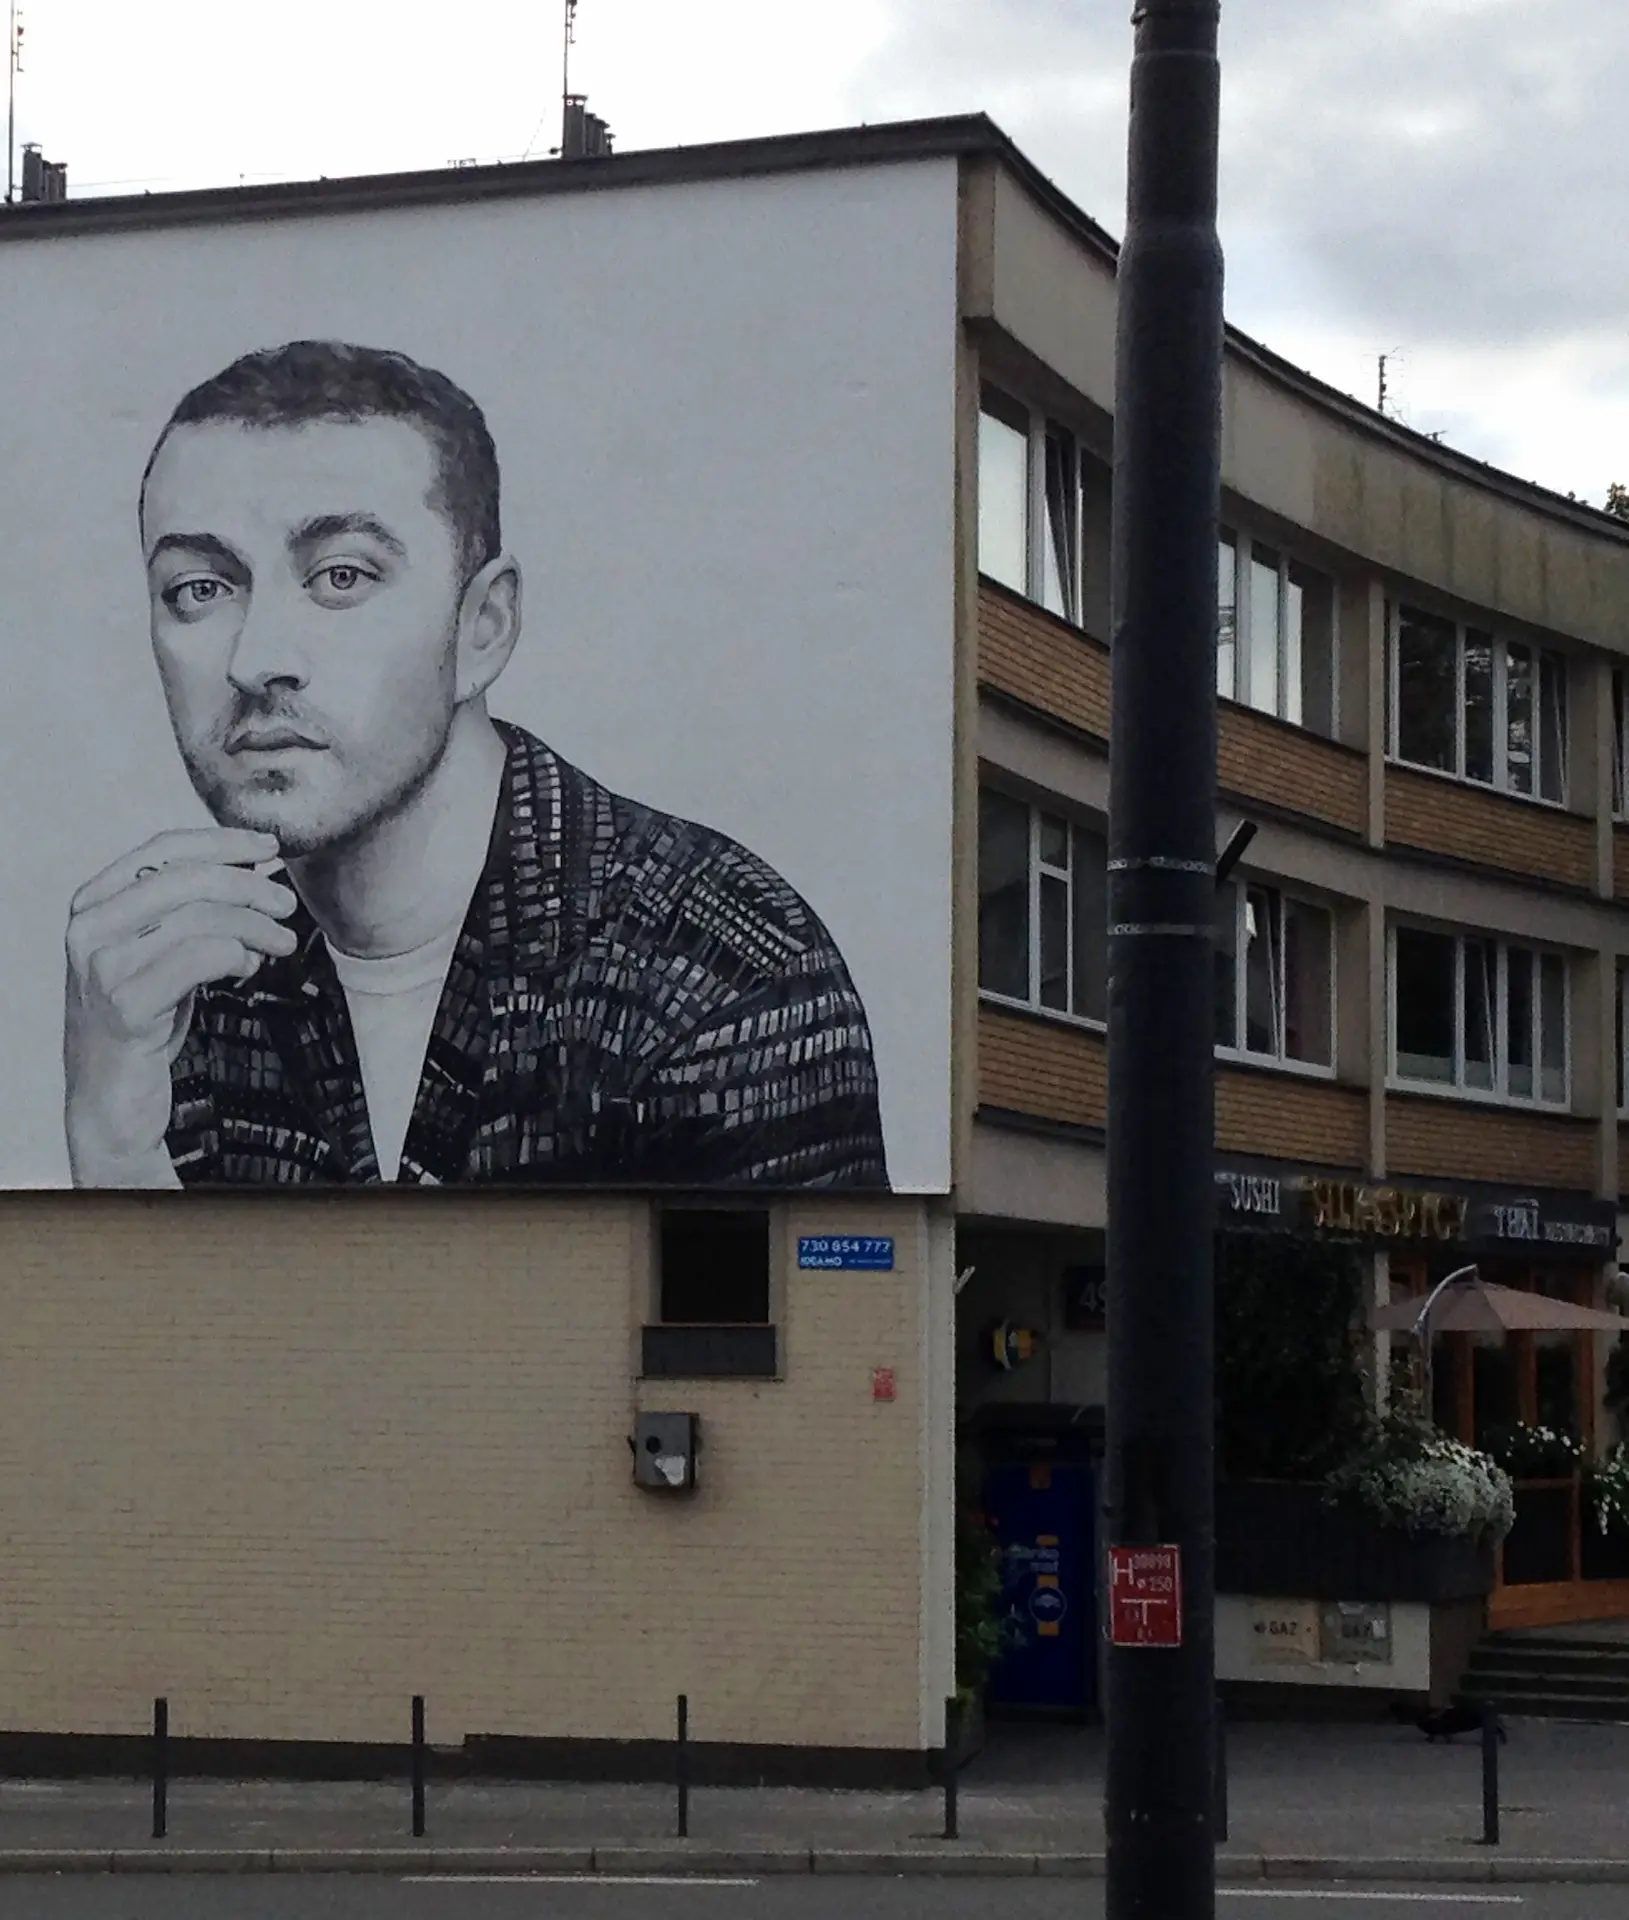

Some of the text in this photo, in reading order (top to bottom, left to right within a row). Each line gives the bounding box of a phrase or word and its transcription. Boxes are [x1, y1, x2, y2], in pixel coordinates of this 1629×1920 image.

[1230, 1173, 1281, 1215] SUSHI
[801, 1239, 829, 1253] 730
[864, 1239, 891, 1253] 777
[1113, 1557, 1134, 1586] H
[1269, 1620, 1298, 1637] GAZ
